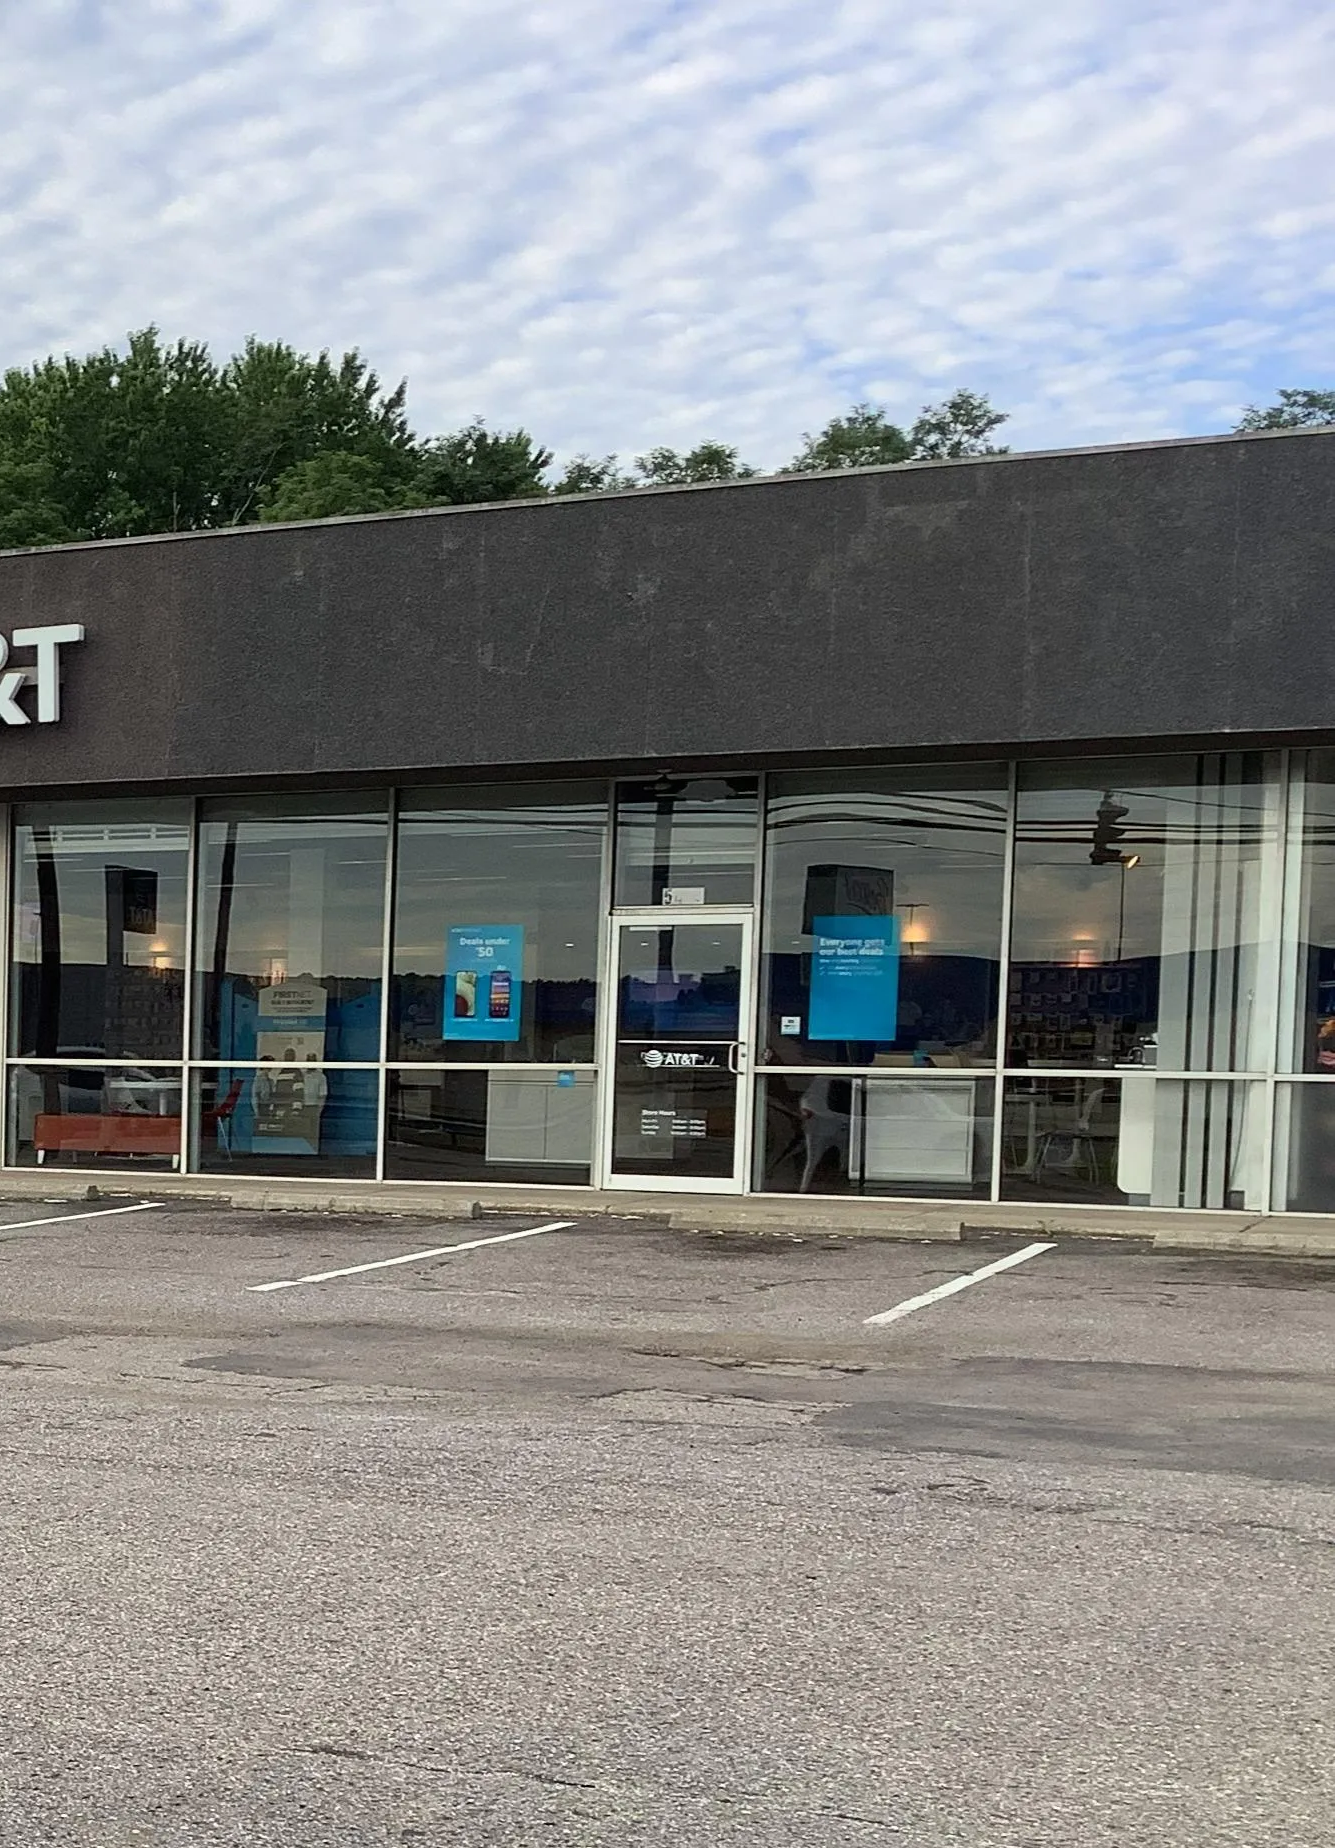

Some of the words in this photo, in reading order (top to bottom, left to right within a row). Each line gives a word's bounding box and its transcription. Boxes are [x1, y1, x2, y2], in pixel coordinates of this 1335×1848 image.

[459, 936, 484, 946] Deals
[484, 936, 511, 945] under
[819, 937, 863, 948] Everyone
[836, 947, 858, 956] best
[858, 947, 884, 956] deals
[664, 1052, 700, 1066] AT&T
